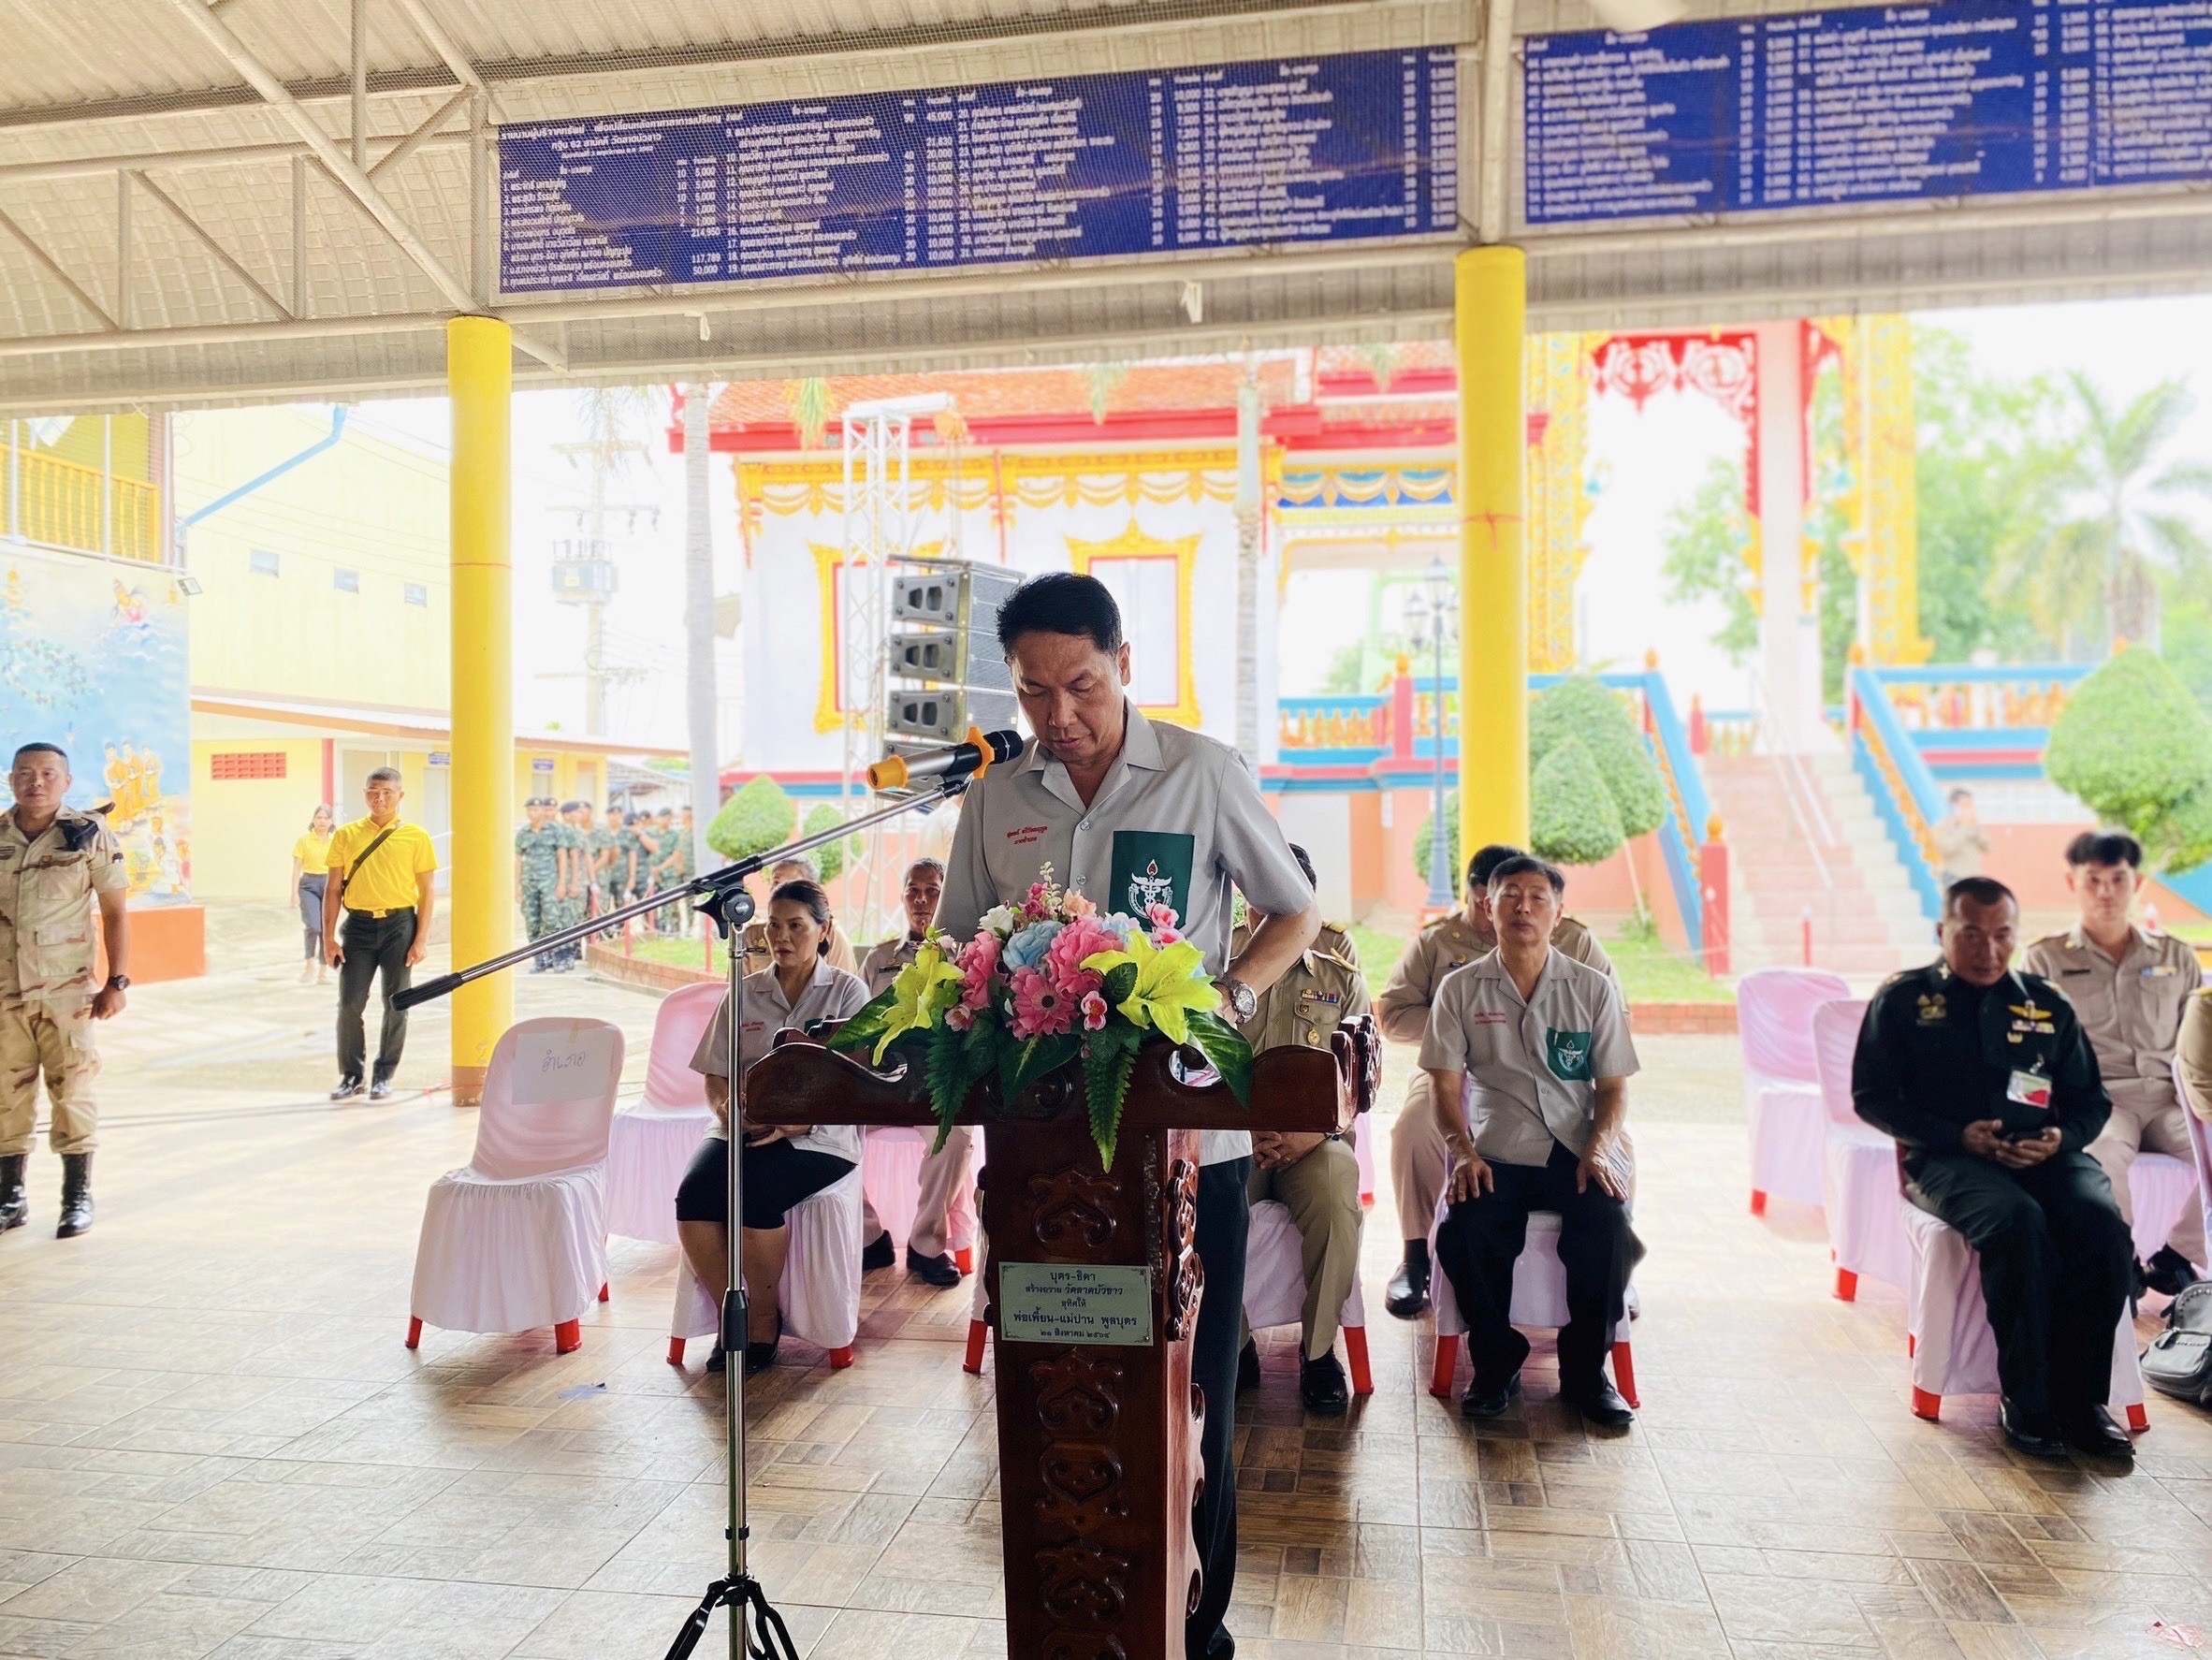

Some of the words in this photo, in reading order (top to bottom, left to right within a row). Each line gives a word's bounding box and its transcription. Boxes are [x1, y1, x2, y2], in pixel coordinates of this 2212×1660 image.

[904, 113, 914, 123] 90
[926, 110, 953, 122] 45,000
[958, 109, 969, 119] 20.
[958, 122, 968, 131] 21.
[552, 140, 568, 151] กฐิน
[584, 137, 608, 147] สามัคคี
[958, 134, 969, 143] 22.
[726, 153, 735, 162] 10.
[926, 137, 953, 146] 21,830
[958, 147, 969, 156] 23.
[726, 166, 736, 174] 11.
[904, 151, 914, 159] 40
[926, 149, 953, 159] 20,000
[959, 160, 970, 169] 24.
[677, 168, 686, 178] 10
[695, 167, 715, 177] 5,000
[726, 178, 736, 186] 12.
[904, 164, 914, 172] 30
[927, 161, 953, 172] 15,000
[959, 172, 970, 182] 25.
[677, 181, 687, 190] 10
[695, 180, 716, 189] 5,000
[726, 191, 735, 199] 13.
[905, 176, 914, 185] 20
[927, 174, 953, 184] 10,000
[959, 184, 970, 194] 26.
[677, 194, 686, 202] 10
[695, 192, 715, 201] 5,000
[905, 188, 914, 198] 20
[927, 187, 953, 197] 10,000
[905, 200, 915, 210] 20
[927, 199, 953, 209] 10,000
[959, 197, 970, 209] 27.
[696, 205, 716, 214] 1,000
[679, 218, 685, 227] 2
[696, 217, 716, 226] 1,000
[905, 214, 915, 224] 20
[927, 212, 953, 223] 10,000
[691, 227, 720, 238] 214,950
[728, 240, 738, 248] 17.
[906, 226, 916, 236] 20
[928, 225, 953, 235] 10,000
[962, 236, 971, 244] 30.
[728, 252, 738, 261] 18.
[906, 240, 916, 249] 20
[928, 238, 953, 248] 10,000
[961, 248, 971, 257] 31.
[691, 253, 720, 264] 117,789
[728, 265, 738, 273] 19.
[906, 252, 916, 262] 20
[928, 249, 953, 260] 10,000
[693, 266, 718, 275] 50,000
[1050, 1269, 1096, 1285] บุตร-ธิดา
[1065, 1283, 1123, 1296] วัดลาดบัวขาว
[1061, 1297, 1086, 1310] อุทิศให้
[1101, 1315, 1138, 1330] พูลบุตร
[1054, 1327, 1084, 1338] สิงหาคม
